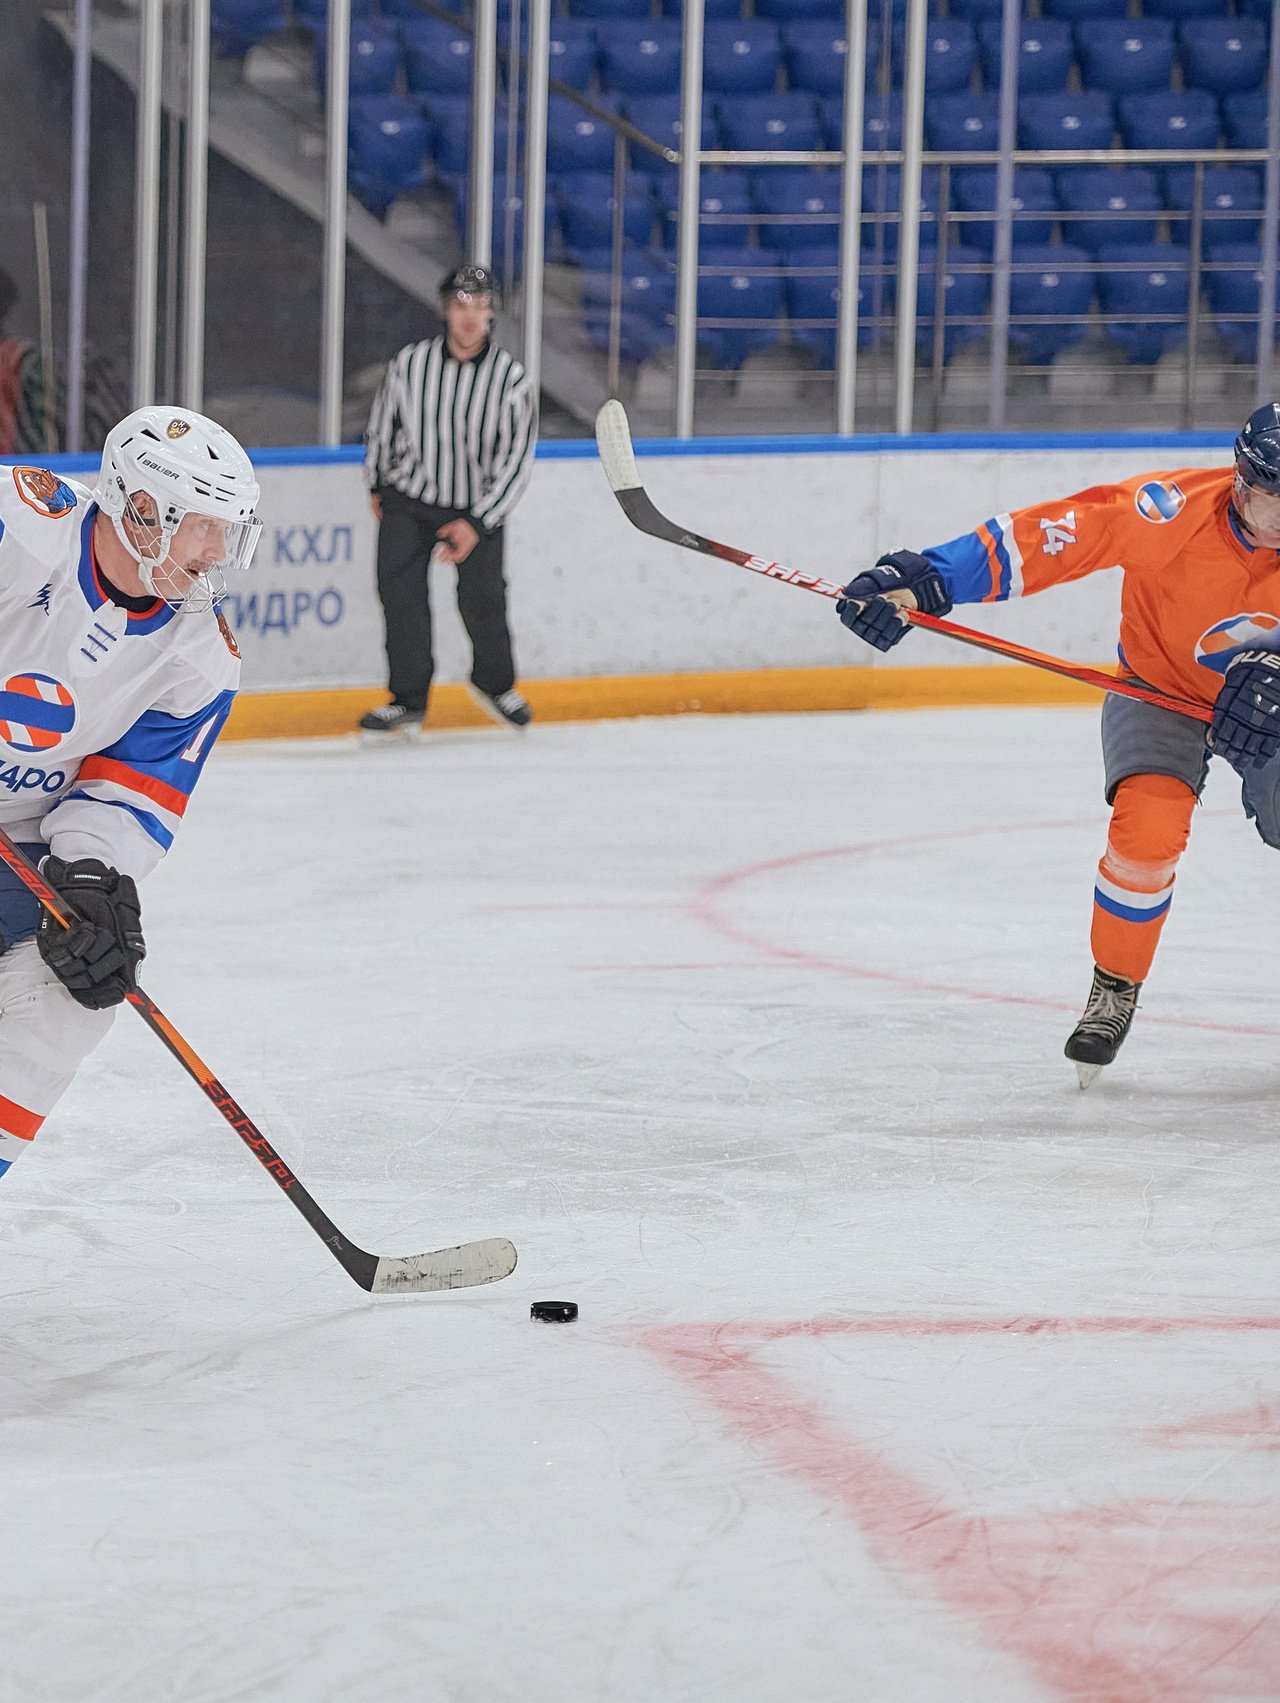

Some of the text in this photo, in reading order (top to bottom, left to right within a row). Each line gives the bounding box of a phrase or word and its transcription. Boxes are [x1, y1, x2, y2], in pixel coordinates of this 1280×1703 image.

[142, 459, 180, 480] BAUER
[274, 525, 352, 564] КХЛ
[1039, 510, 1078, 556] 74
[180, 711, 219, 764] 1
